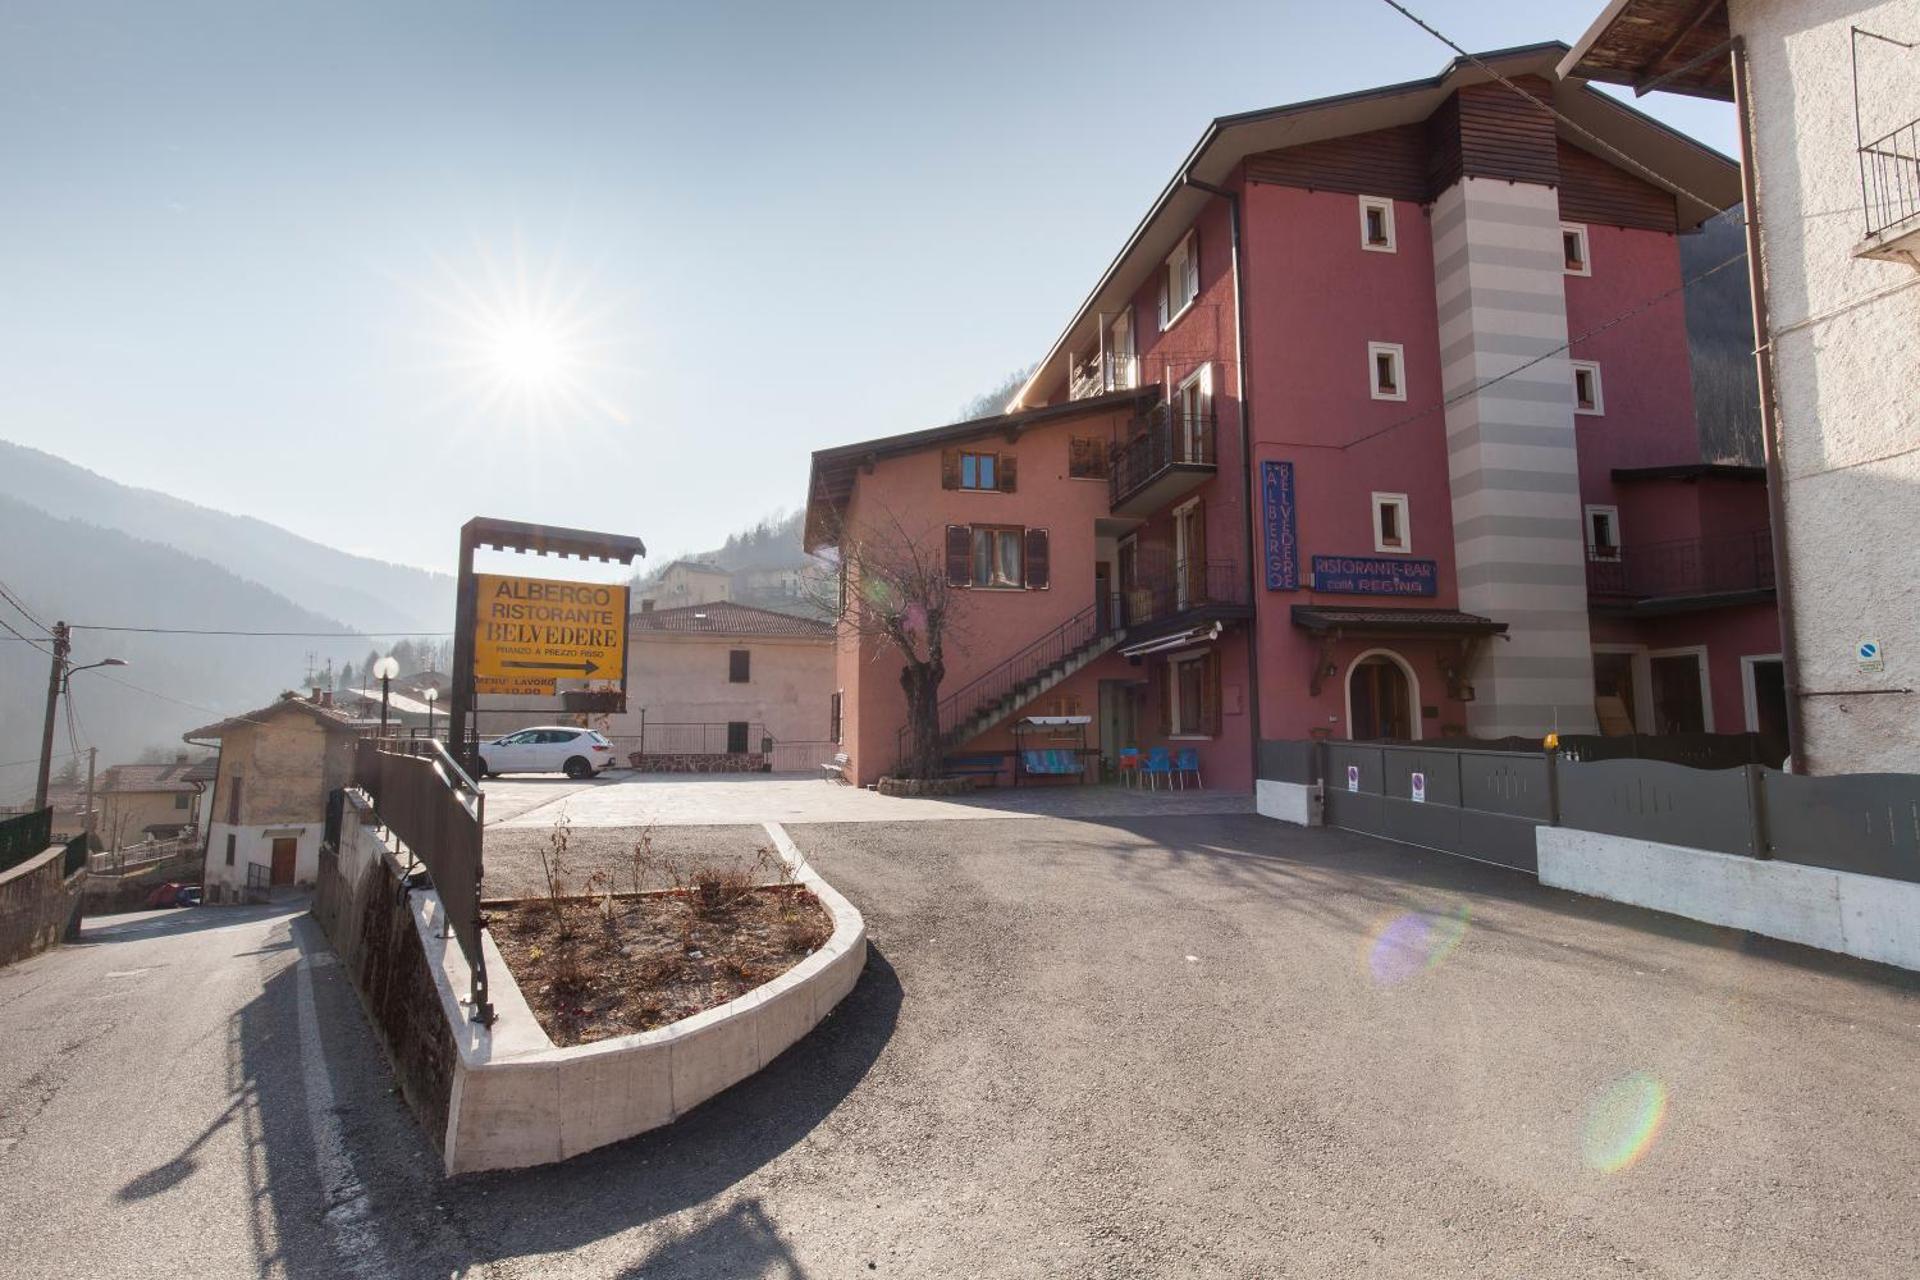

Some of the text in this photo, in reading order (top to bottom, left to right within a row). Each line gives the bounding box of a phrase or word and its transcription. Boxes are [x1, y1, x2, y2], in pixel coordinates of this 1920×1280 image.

[1266, 472, 1282, 587] ALBERGO
[1280, 464, 1295, 588] BELVEDERE
[495, 581, 610, 606] ALBERGO
[492, 603, 613, 625] RISTORANTE
[486, 622, 617, 647] BELVEDERE
[545, 649, 577, 657] PREZZO
